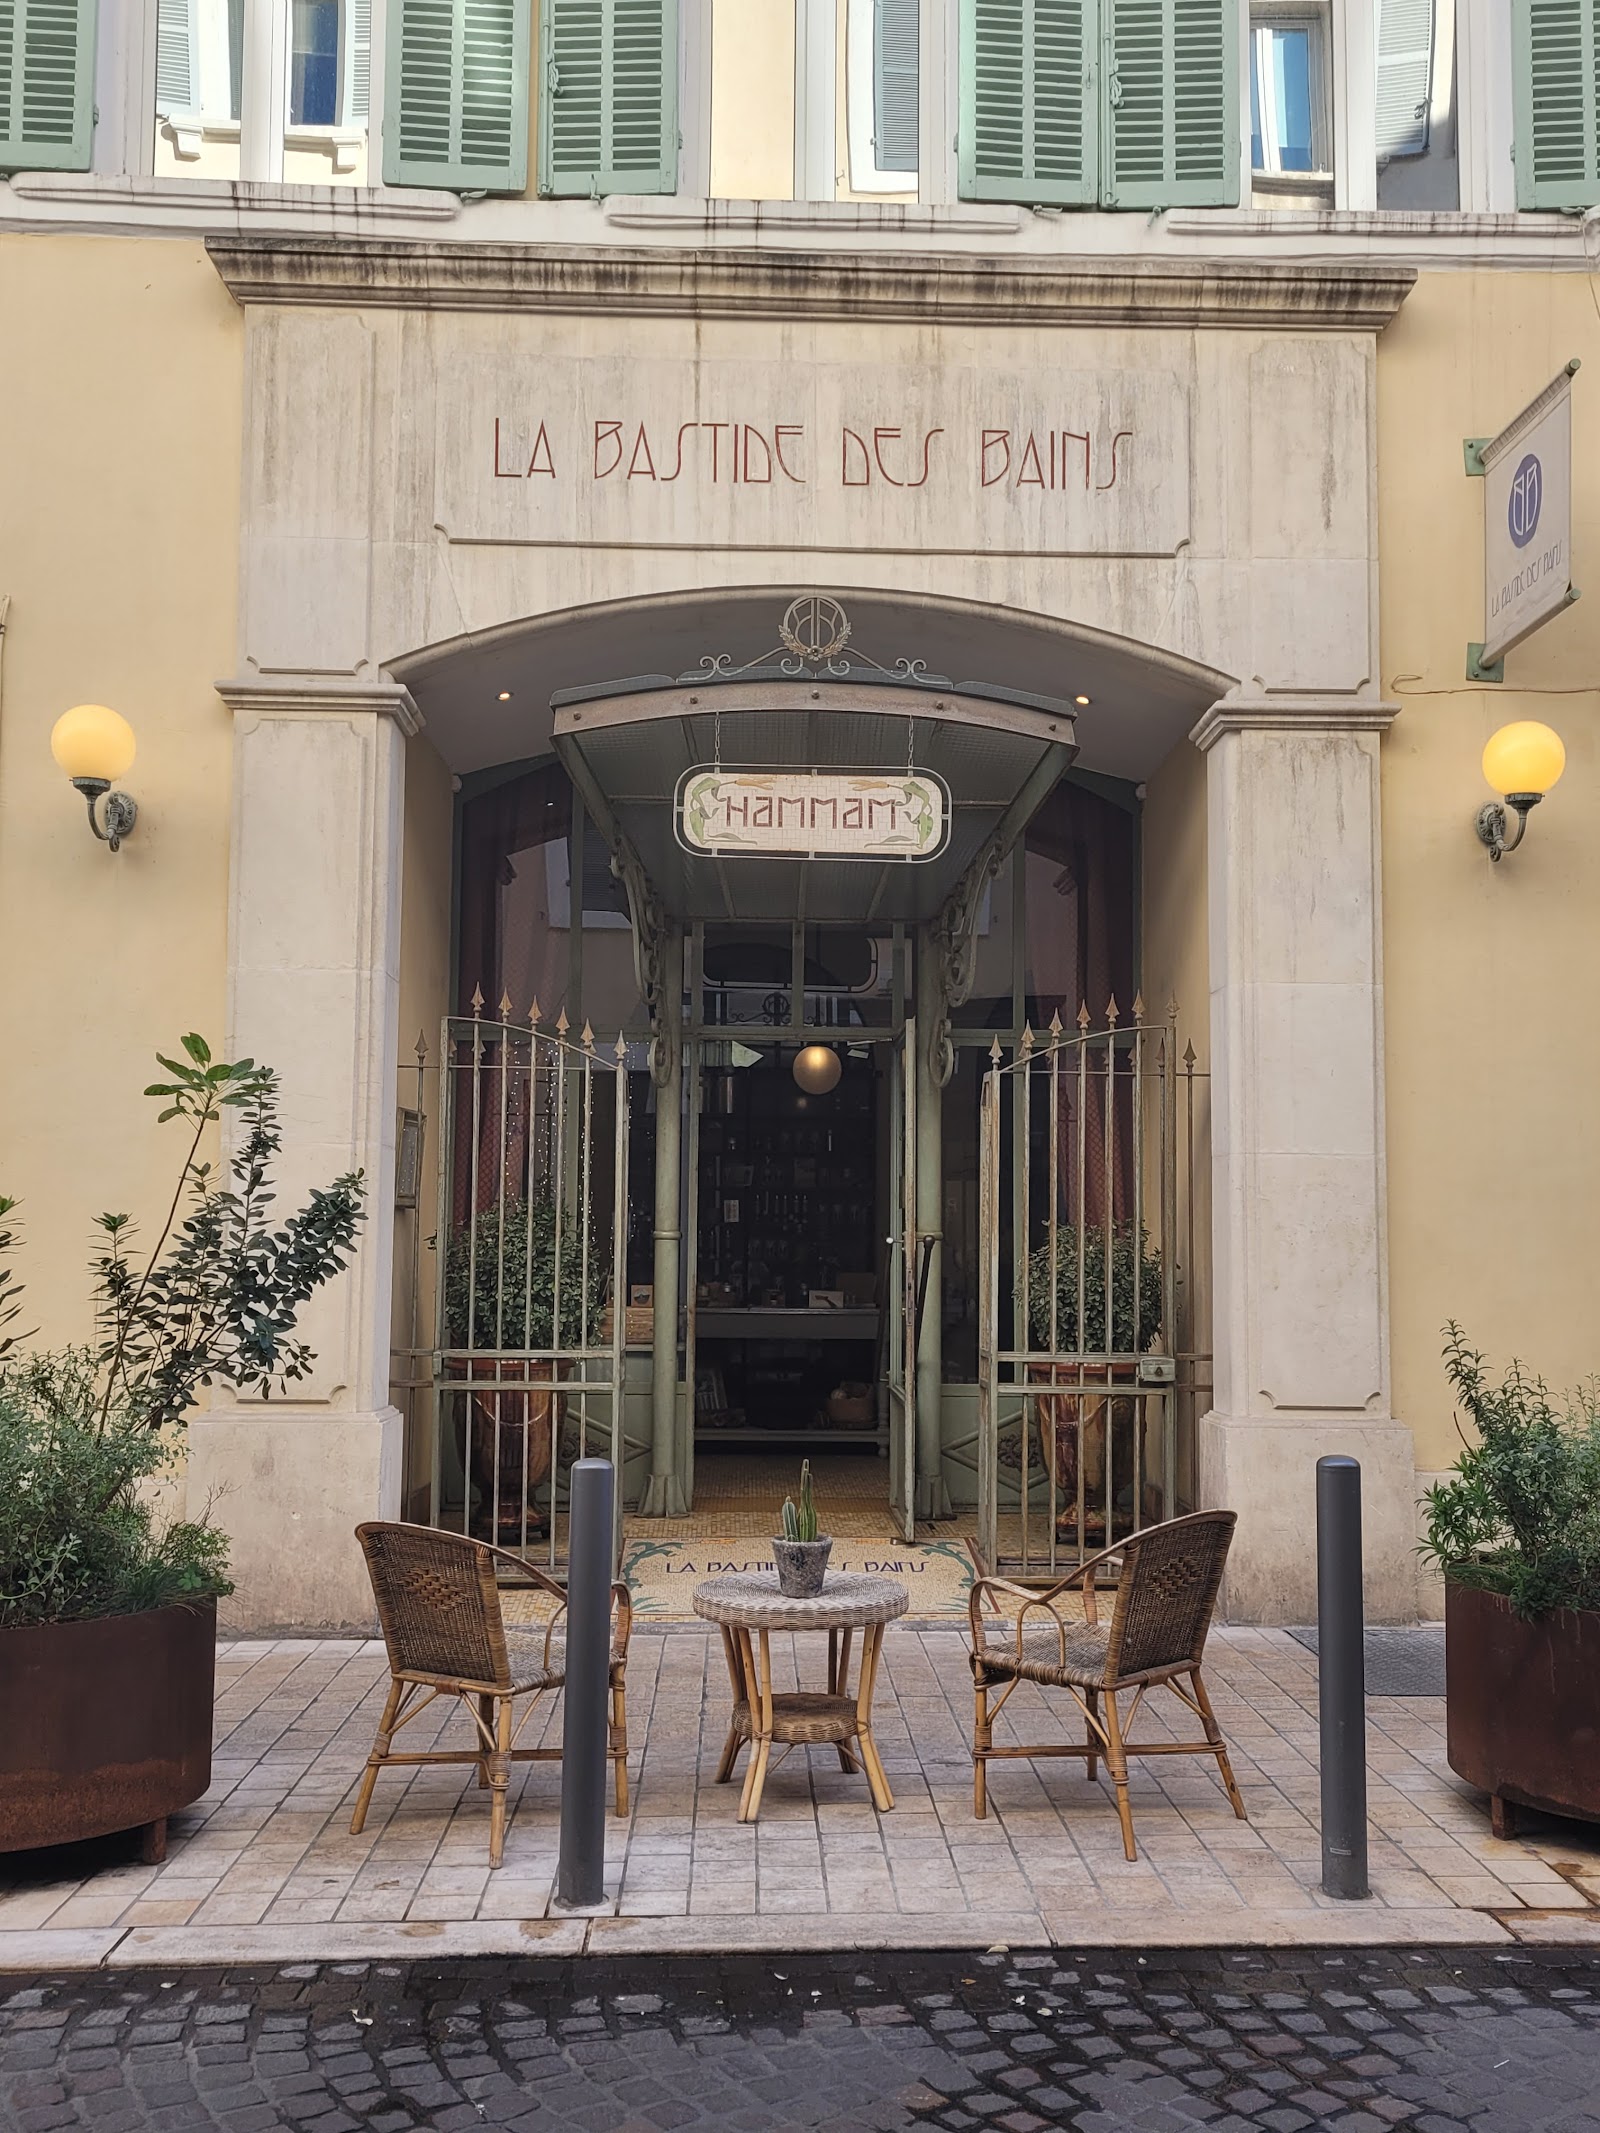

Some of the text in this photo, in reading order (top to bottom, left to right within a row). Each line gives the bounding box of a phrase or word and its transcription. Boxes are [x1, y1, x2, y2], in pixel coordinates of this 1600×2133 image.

[494, 417, 1133, 490] LA BASTIDE DES BAINS
[666, 1562, 696, 1573] LA
[864, 1561, 929, 1572] BAINS
